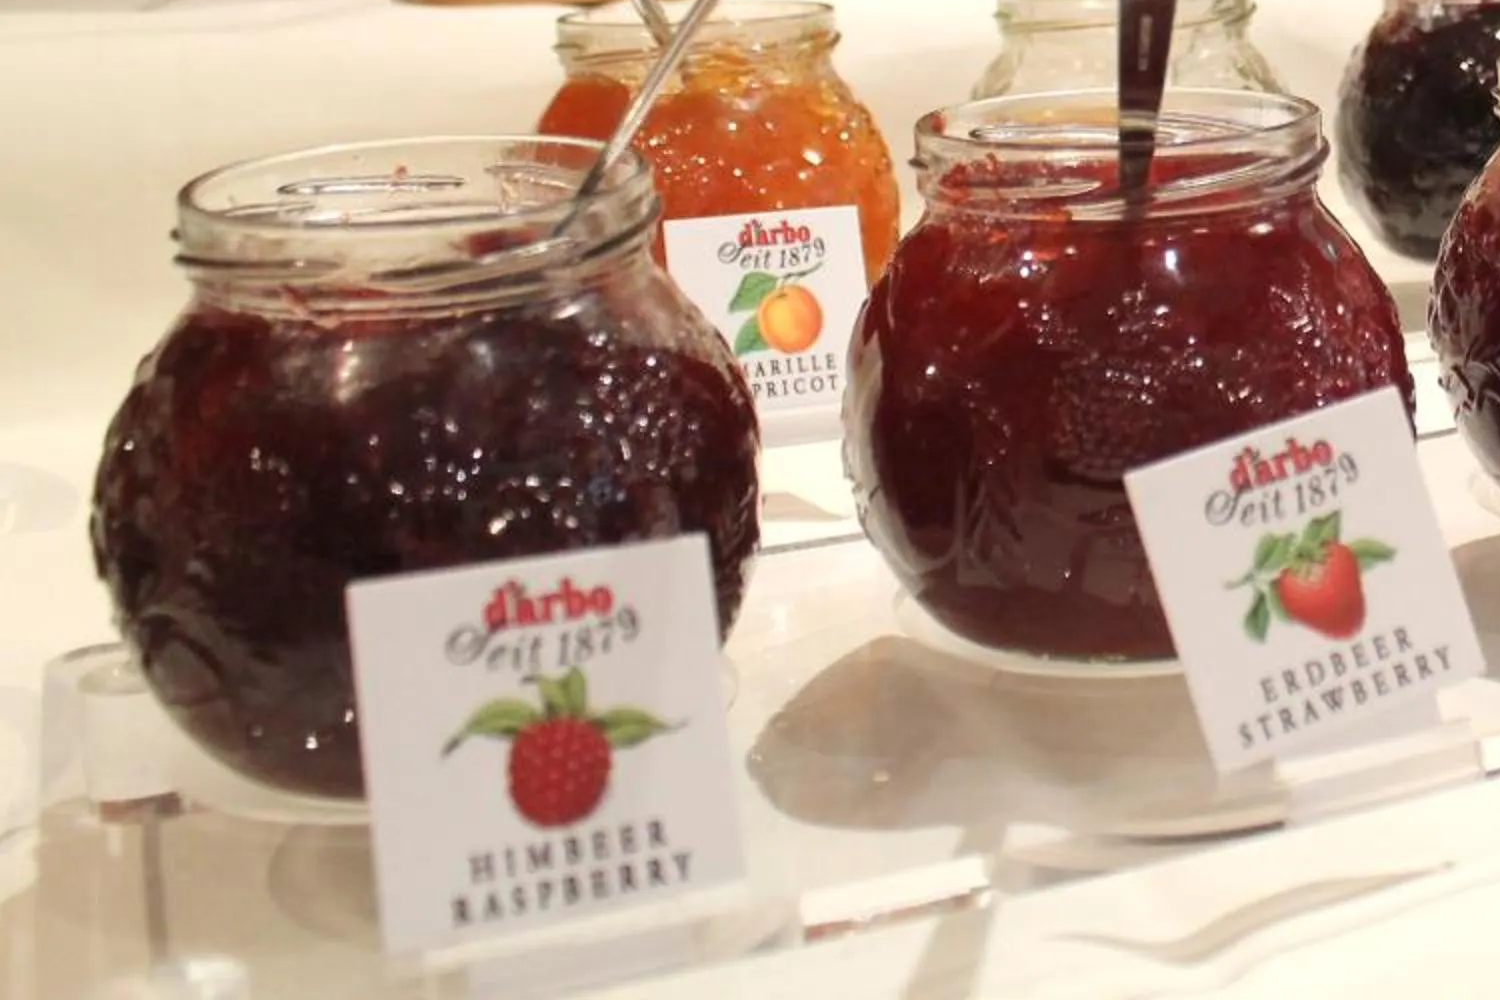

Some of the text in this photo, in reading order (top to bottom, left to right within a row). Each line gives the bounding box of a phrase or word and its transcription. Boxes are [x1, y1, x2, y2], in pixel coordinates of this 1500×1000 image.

[717, 237, 826, 269] Seit 1879
[743, 352, 837, 378] ARILLE
[752, 374, 839, 399] PRICOT
[1204, 452, 1359, 527] Seit 1879
[444, 606, 641, 671] Seit 1879
[1259, 626, 1413, 704] ERDBEER
[1237, 646, 1452, 750] STRAWBERRY
[468, 820, 668, 885] HIMBEER
[451, 851, 692, 928] RASPBERRY
